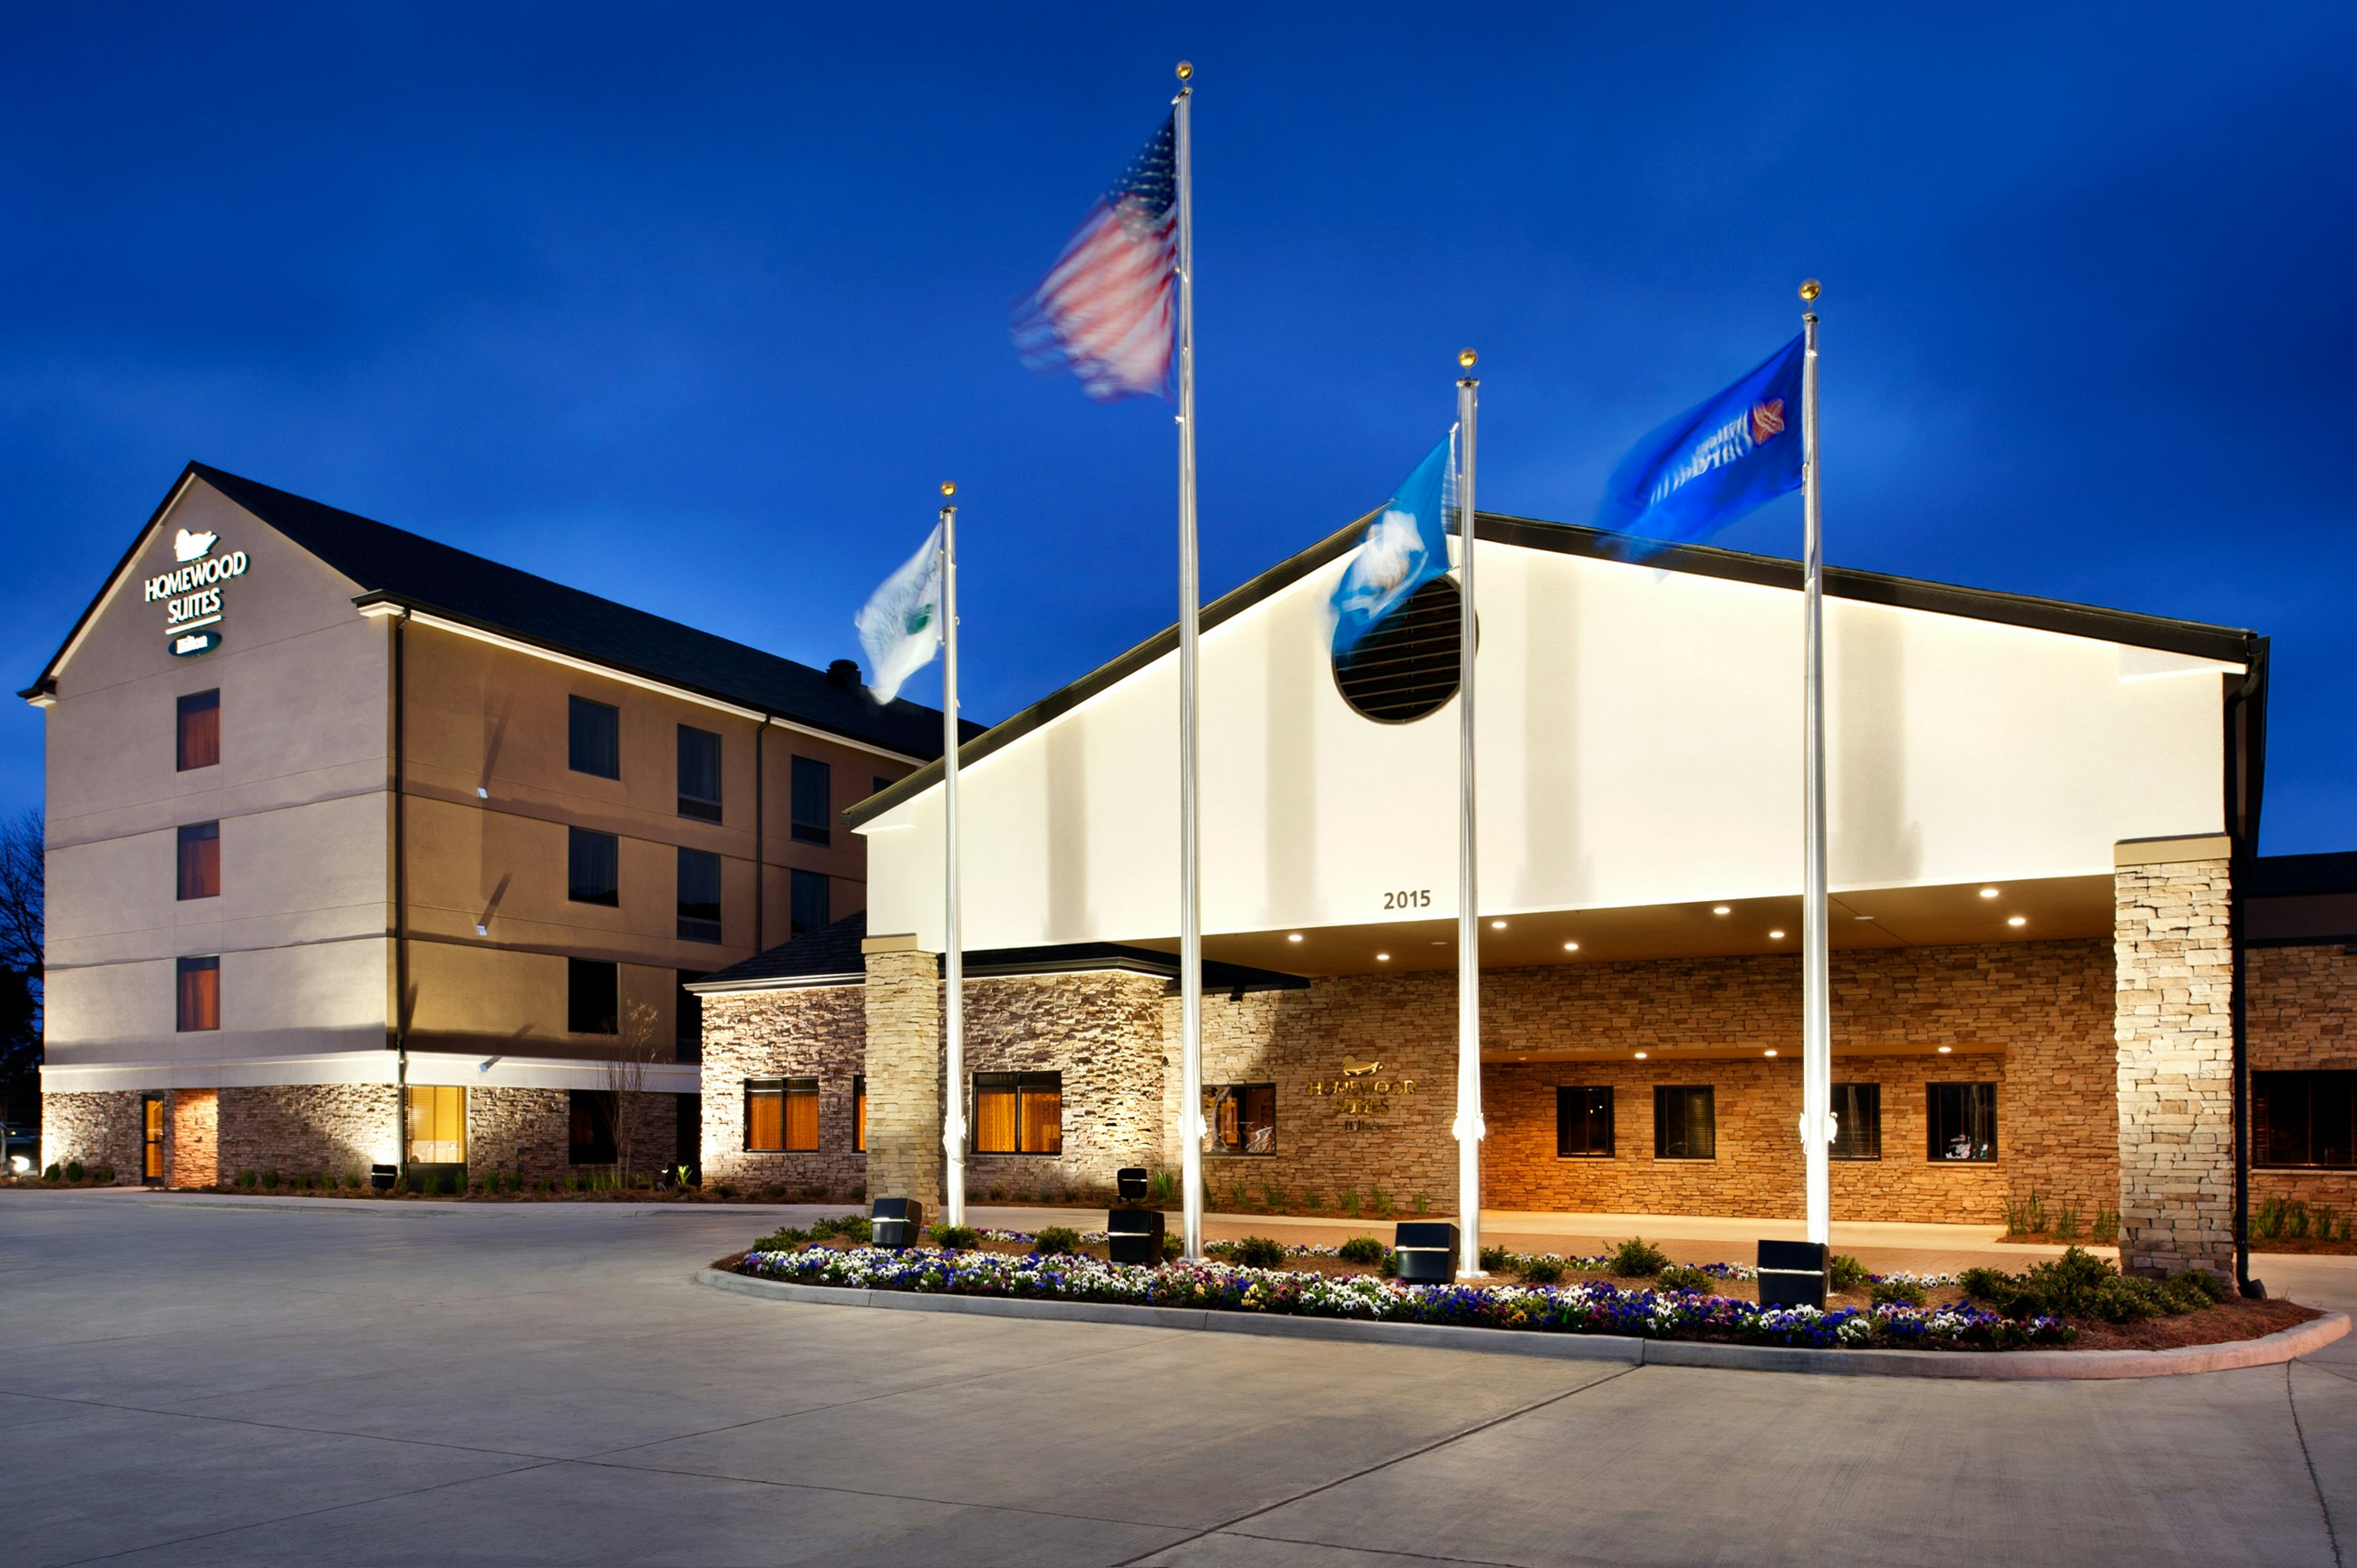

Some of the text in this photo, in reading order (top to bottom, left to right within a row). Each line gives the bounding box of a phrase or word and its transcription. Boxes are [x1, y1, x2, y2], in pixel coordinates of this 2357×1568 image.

[145, 551, 247, 602] HOMEWOOD
[168, 587, 221, 624] SUITES
[1383, 889, 1431, 910] 2015
